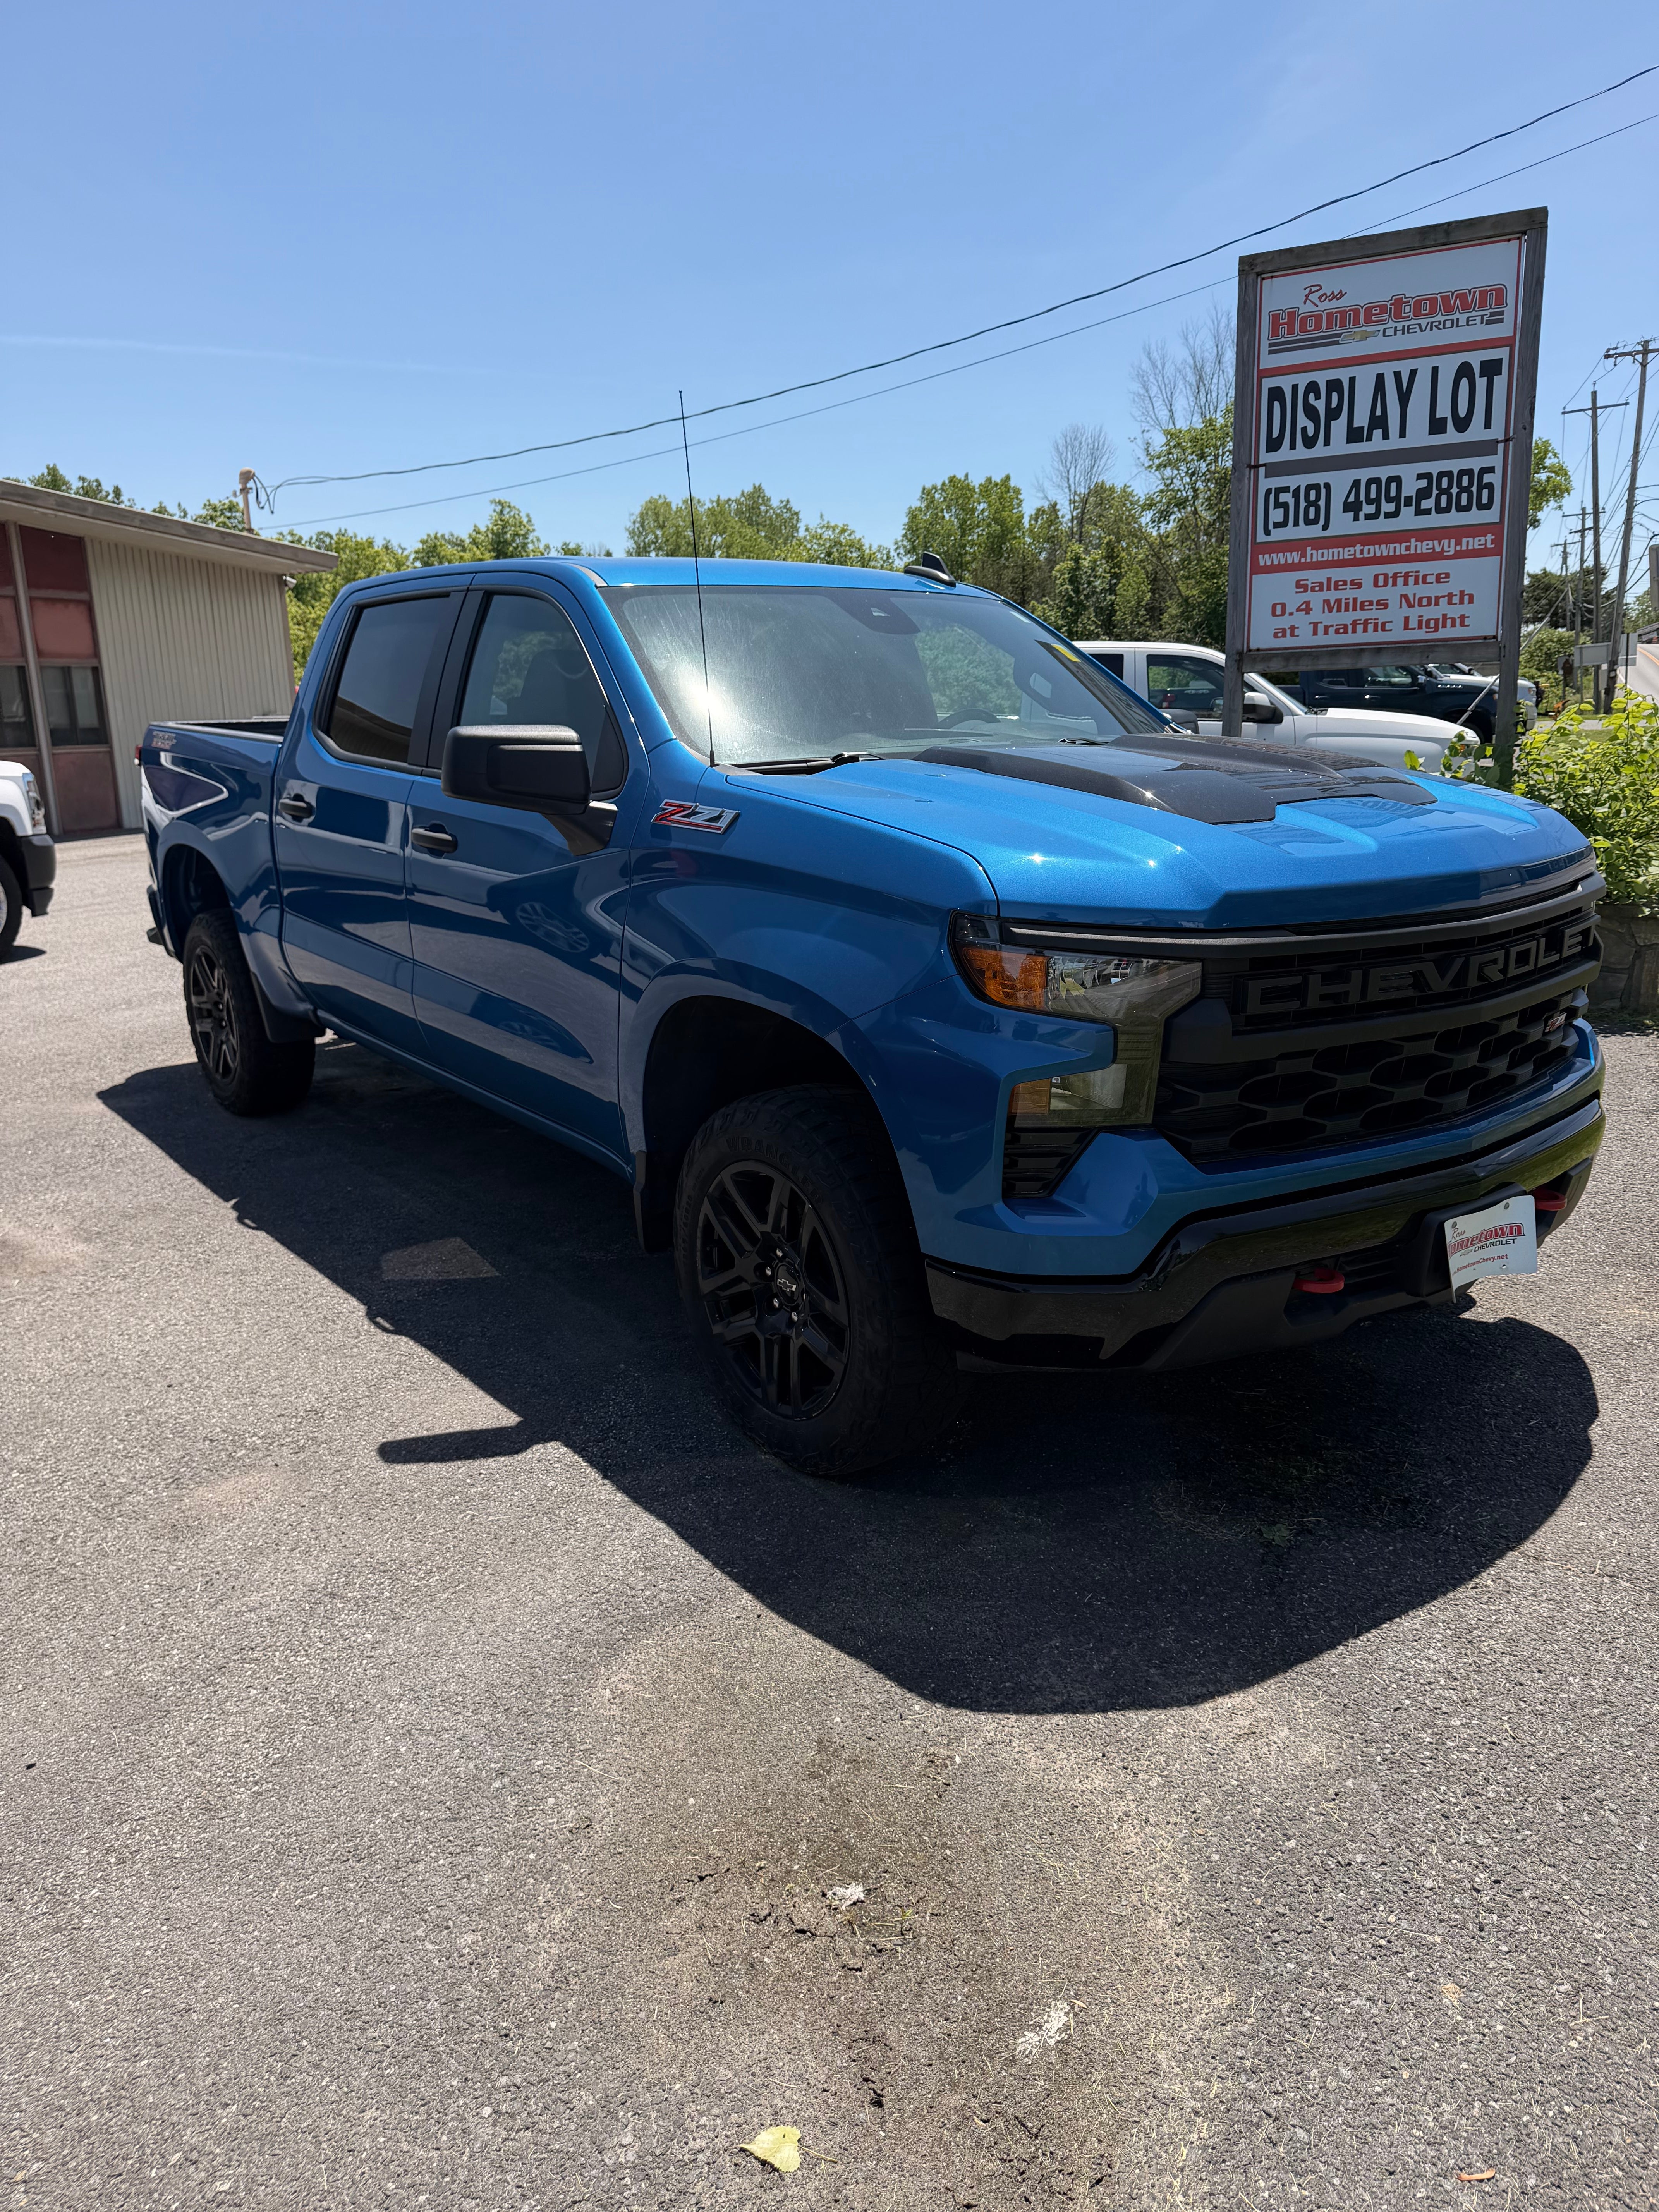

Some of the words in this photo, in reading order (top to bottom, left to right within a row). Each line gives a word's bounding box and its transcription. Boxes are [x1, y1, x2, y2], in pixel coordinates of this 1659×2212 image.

[1304, 284, 1347, 307] Ross
[1268, 284, 1507, 340] Hometown
[1382, 315, 1487, 337] CHEVROLET
[1266, 368, 1418, 453] DISPLAY
[1428, 358, 1503, 436] LOT
[1264, 482, 1331, 536] (518)
[1343, 466, 1496, 522] 499-2886
[1259, 534, 1495, 566] www.hometownchevy.net
[1295, 577, 1363, 594] Sales
[1373, 570, 1451, 589] Office
[1271, 600, 1313, 617] 0.4
[1322, 596, 1389, 614] Miles
[1400, 590, 1474, 608] North
[1273, 624, 1299, 638] at
[1309, 618, 1393, 636] Traffic
[1403, 613, 1470, 633] Light
[651, 799, 740, 834] Z71
[1244, 915, 1601, 1013] CHEVROLET
[1474, 1239, 1517, 1252] CHEVROLET
